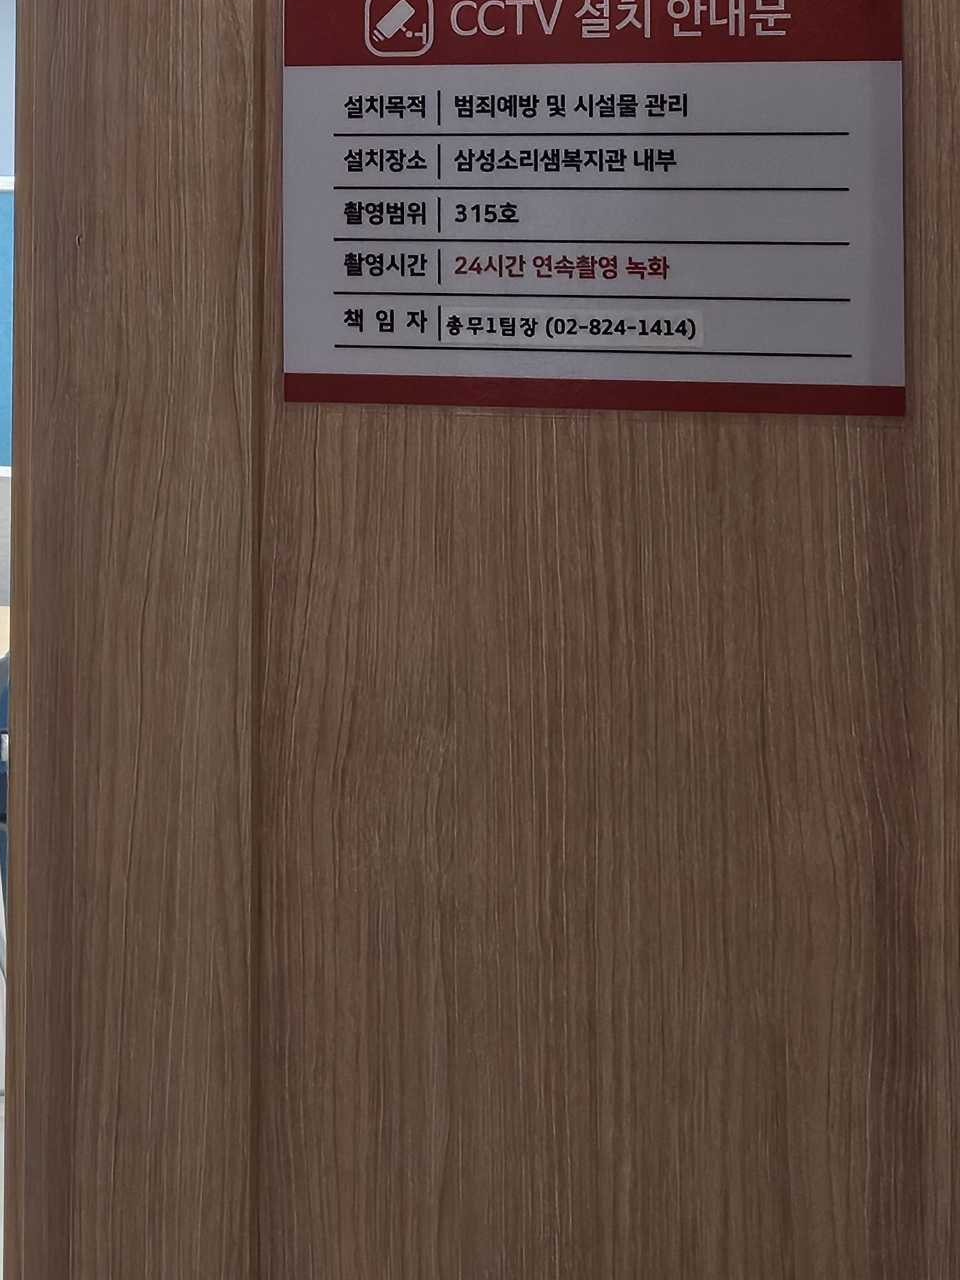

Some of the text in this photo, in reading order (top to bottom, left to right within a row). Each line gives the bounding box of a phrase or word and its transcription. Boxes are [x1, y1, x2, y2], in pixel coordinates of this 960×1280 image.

[450, 0, 563, 36] CCTV
[343, 93, 688, 120] 설치목적 범죄예방 및 시설물 관리
[343, 148, 678, 173] 설치장소 삼성소리샘복지관 내부
[343, 200, 520, 226] 촬영범위 315호
[343, 251, 671, 281] 촬영시간 24시간 연속촬영 녹화
[445, 314, 539, 338] 총무1팀장
[545, 316, 697, 341] (02-824-1414)
